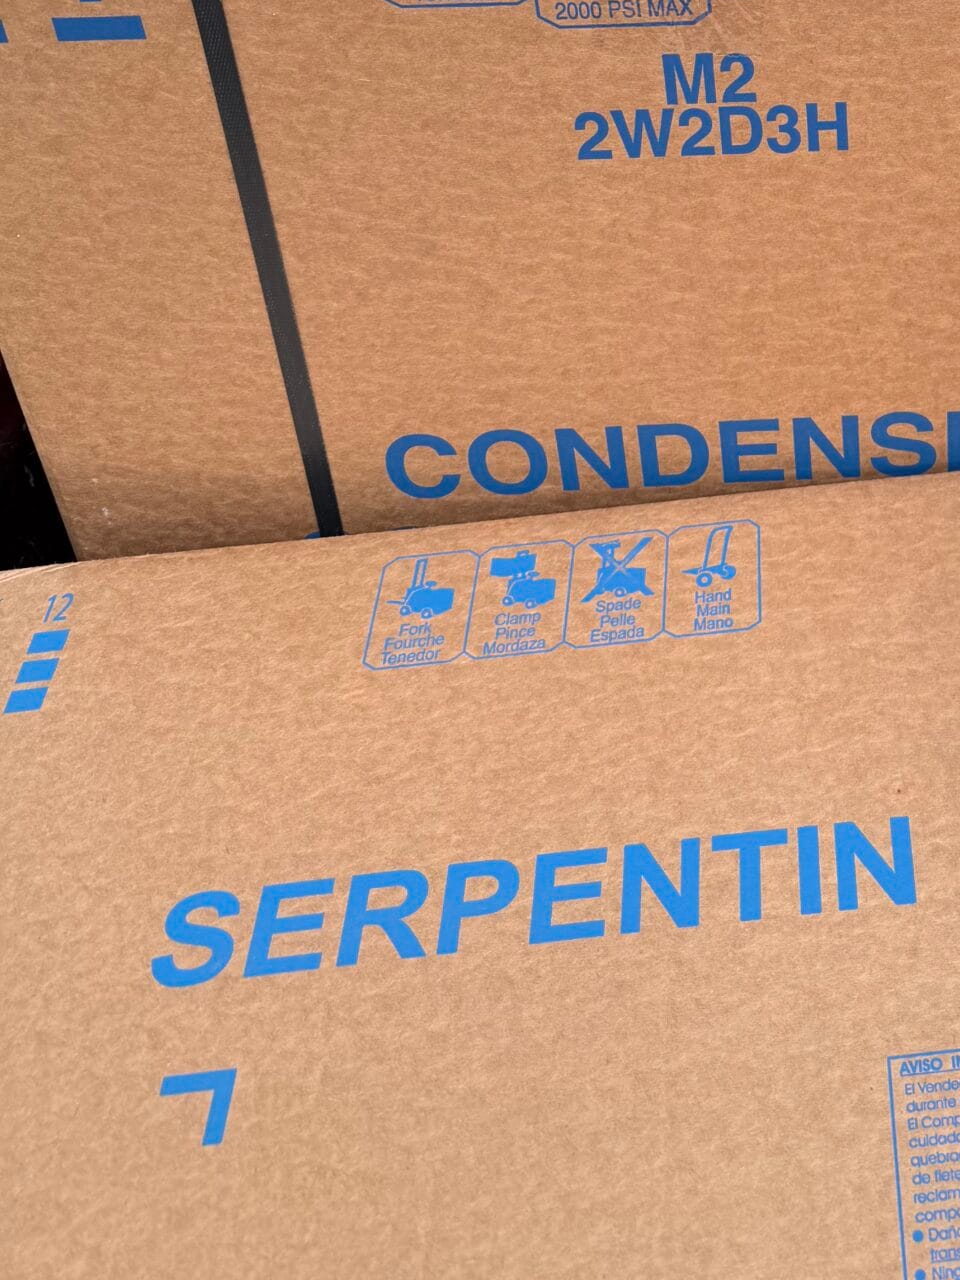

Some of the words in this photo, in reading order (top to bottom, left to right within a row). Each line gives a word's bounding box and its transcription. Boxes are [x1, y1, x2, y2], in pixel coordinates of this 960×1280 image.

[555, 0, 602, 20] 2000
[661, 52, 757, 105] M2
[574, 102, 849, 161] 2W2D3H
[694, 588, 732, 604] Hand
[43, 592, 74, 623] 12
[595, 598, 642, 615] Spade
[695, 603, 731, 617] Main
[494, 611, 542, 628] Clamp
[600, 613, 636, 627] Pelle
[693, 616, 734, 631] Mano
[399, 622, 432, 637] Fork
[495, 625, 536, 639] Pince
[589, 626, 645, 643] Espada
[384, 634, 445, 651] Fourche
[483, 637, 546, 655] Mordaza
[381, 648, 440, 666] Tenedor
[150, 815, 918, 988] SERPENTIN
[899, 1057, 943, 1076] AVISO
[904, 1084, 915, 1096] El
[907, 1118, 919, 1132] El
[912, 1174, 931, 1186] de
